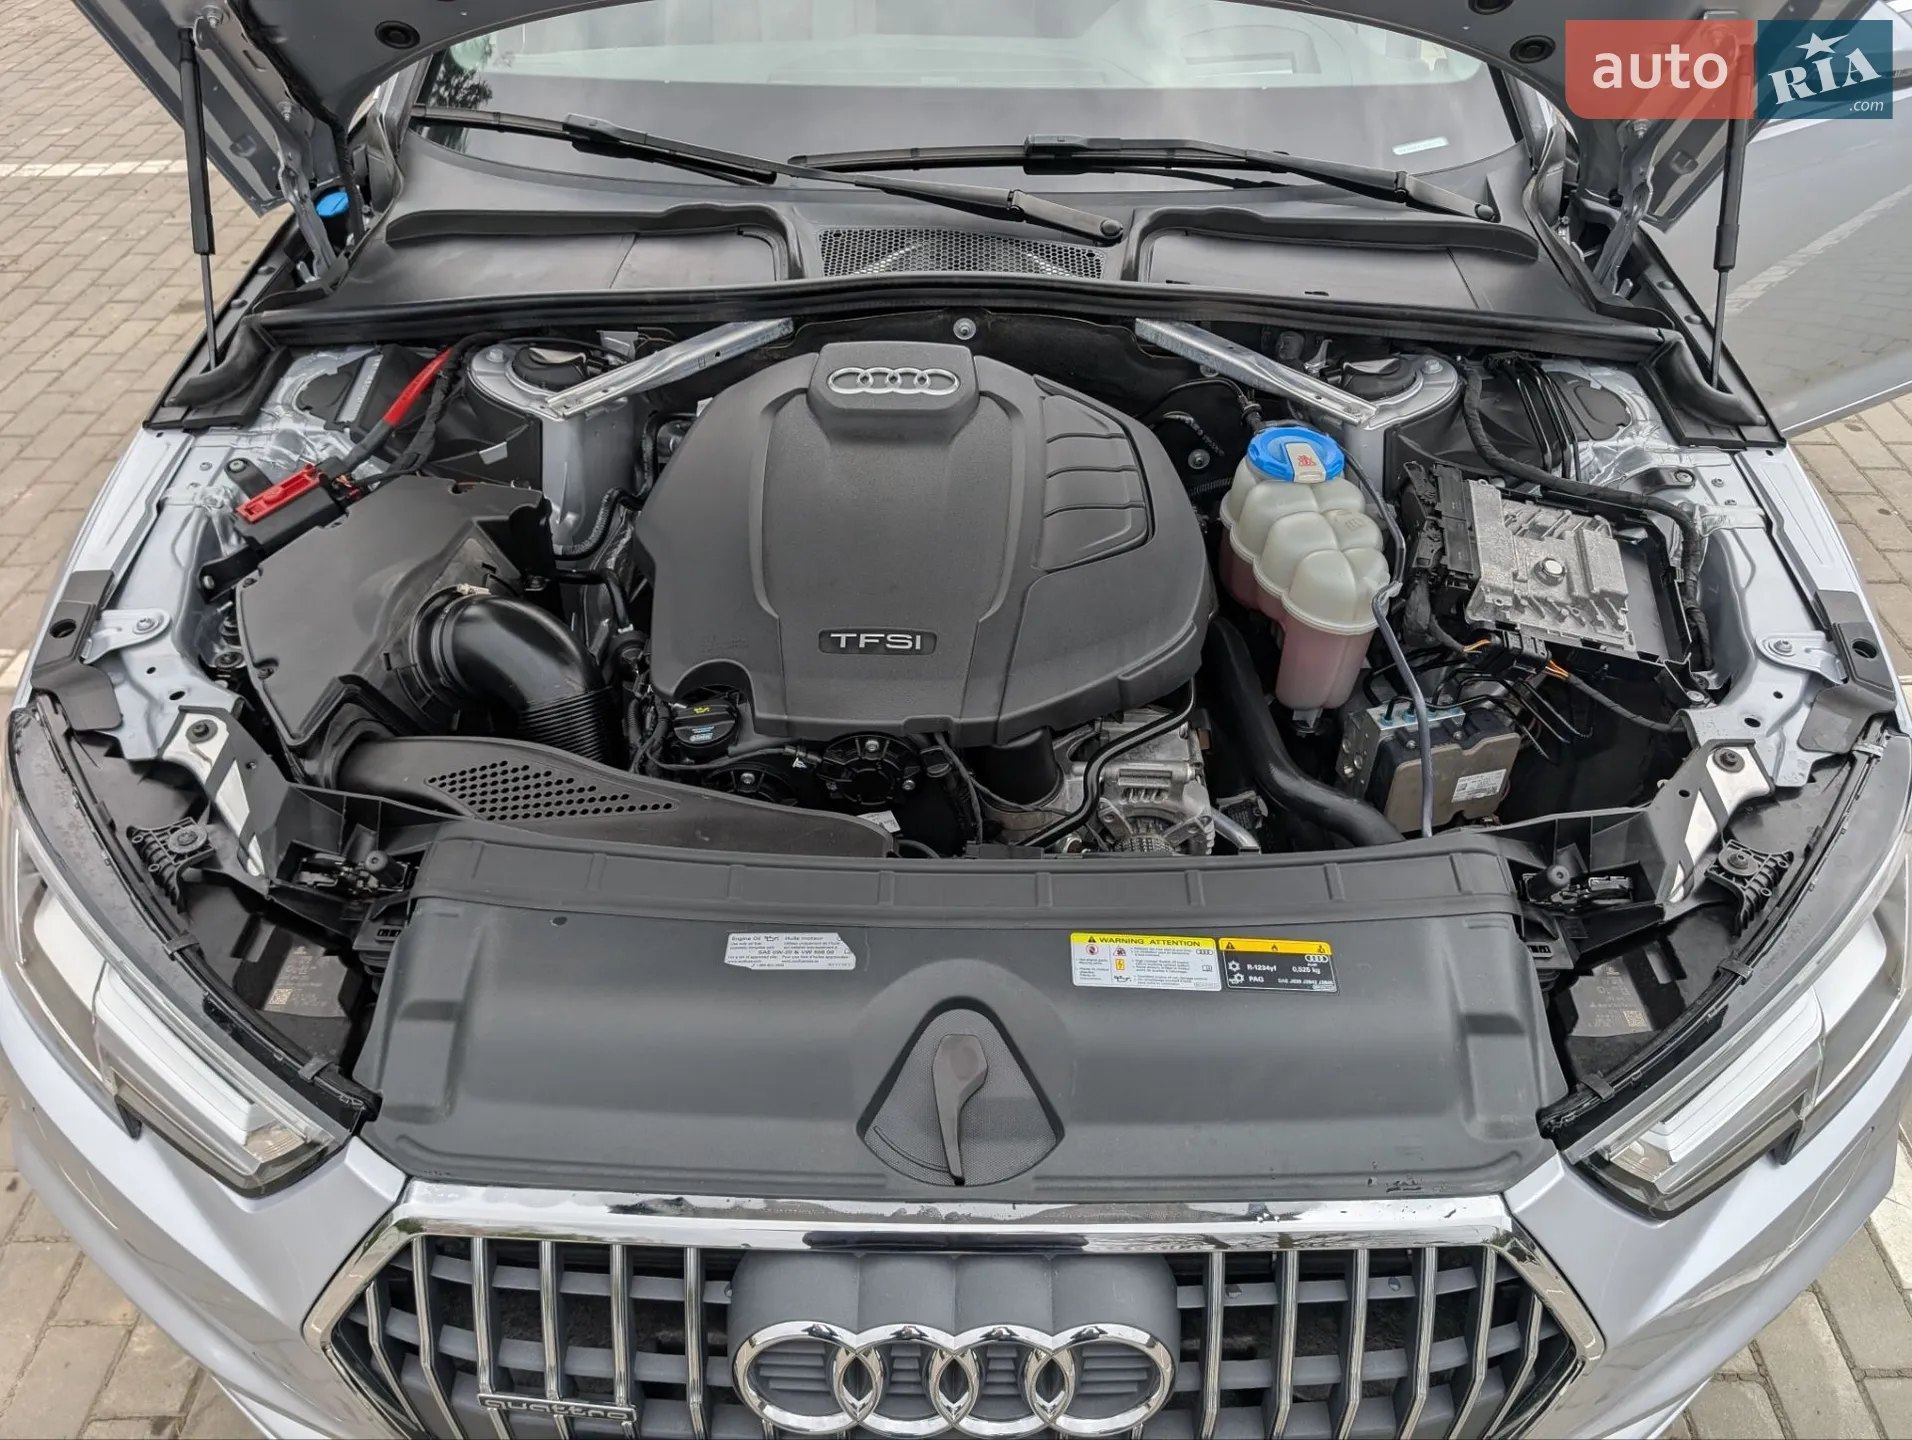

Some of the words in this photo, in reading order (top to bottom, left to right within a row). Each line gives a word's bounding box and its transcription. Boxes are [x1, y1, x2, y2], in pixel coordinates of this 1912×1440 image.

[830, 633, 921, 650] TFSI
[1099, 937, 1144, 945] WARNING
[1149, 938, 1201, 947] ATTENTION
[1248, 975, 1265, 983] PAG
[484, 1399, 628, 1420] quattro
